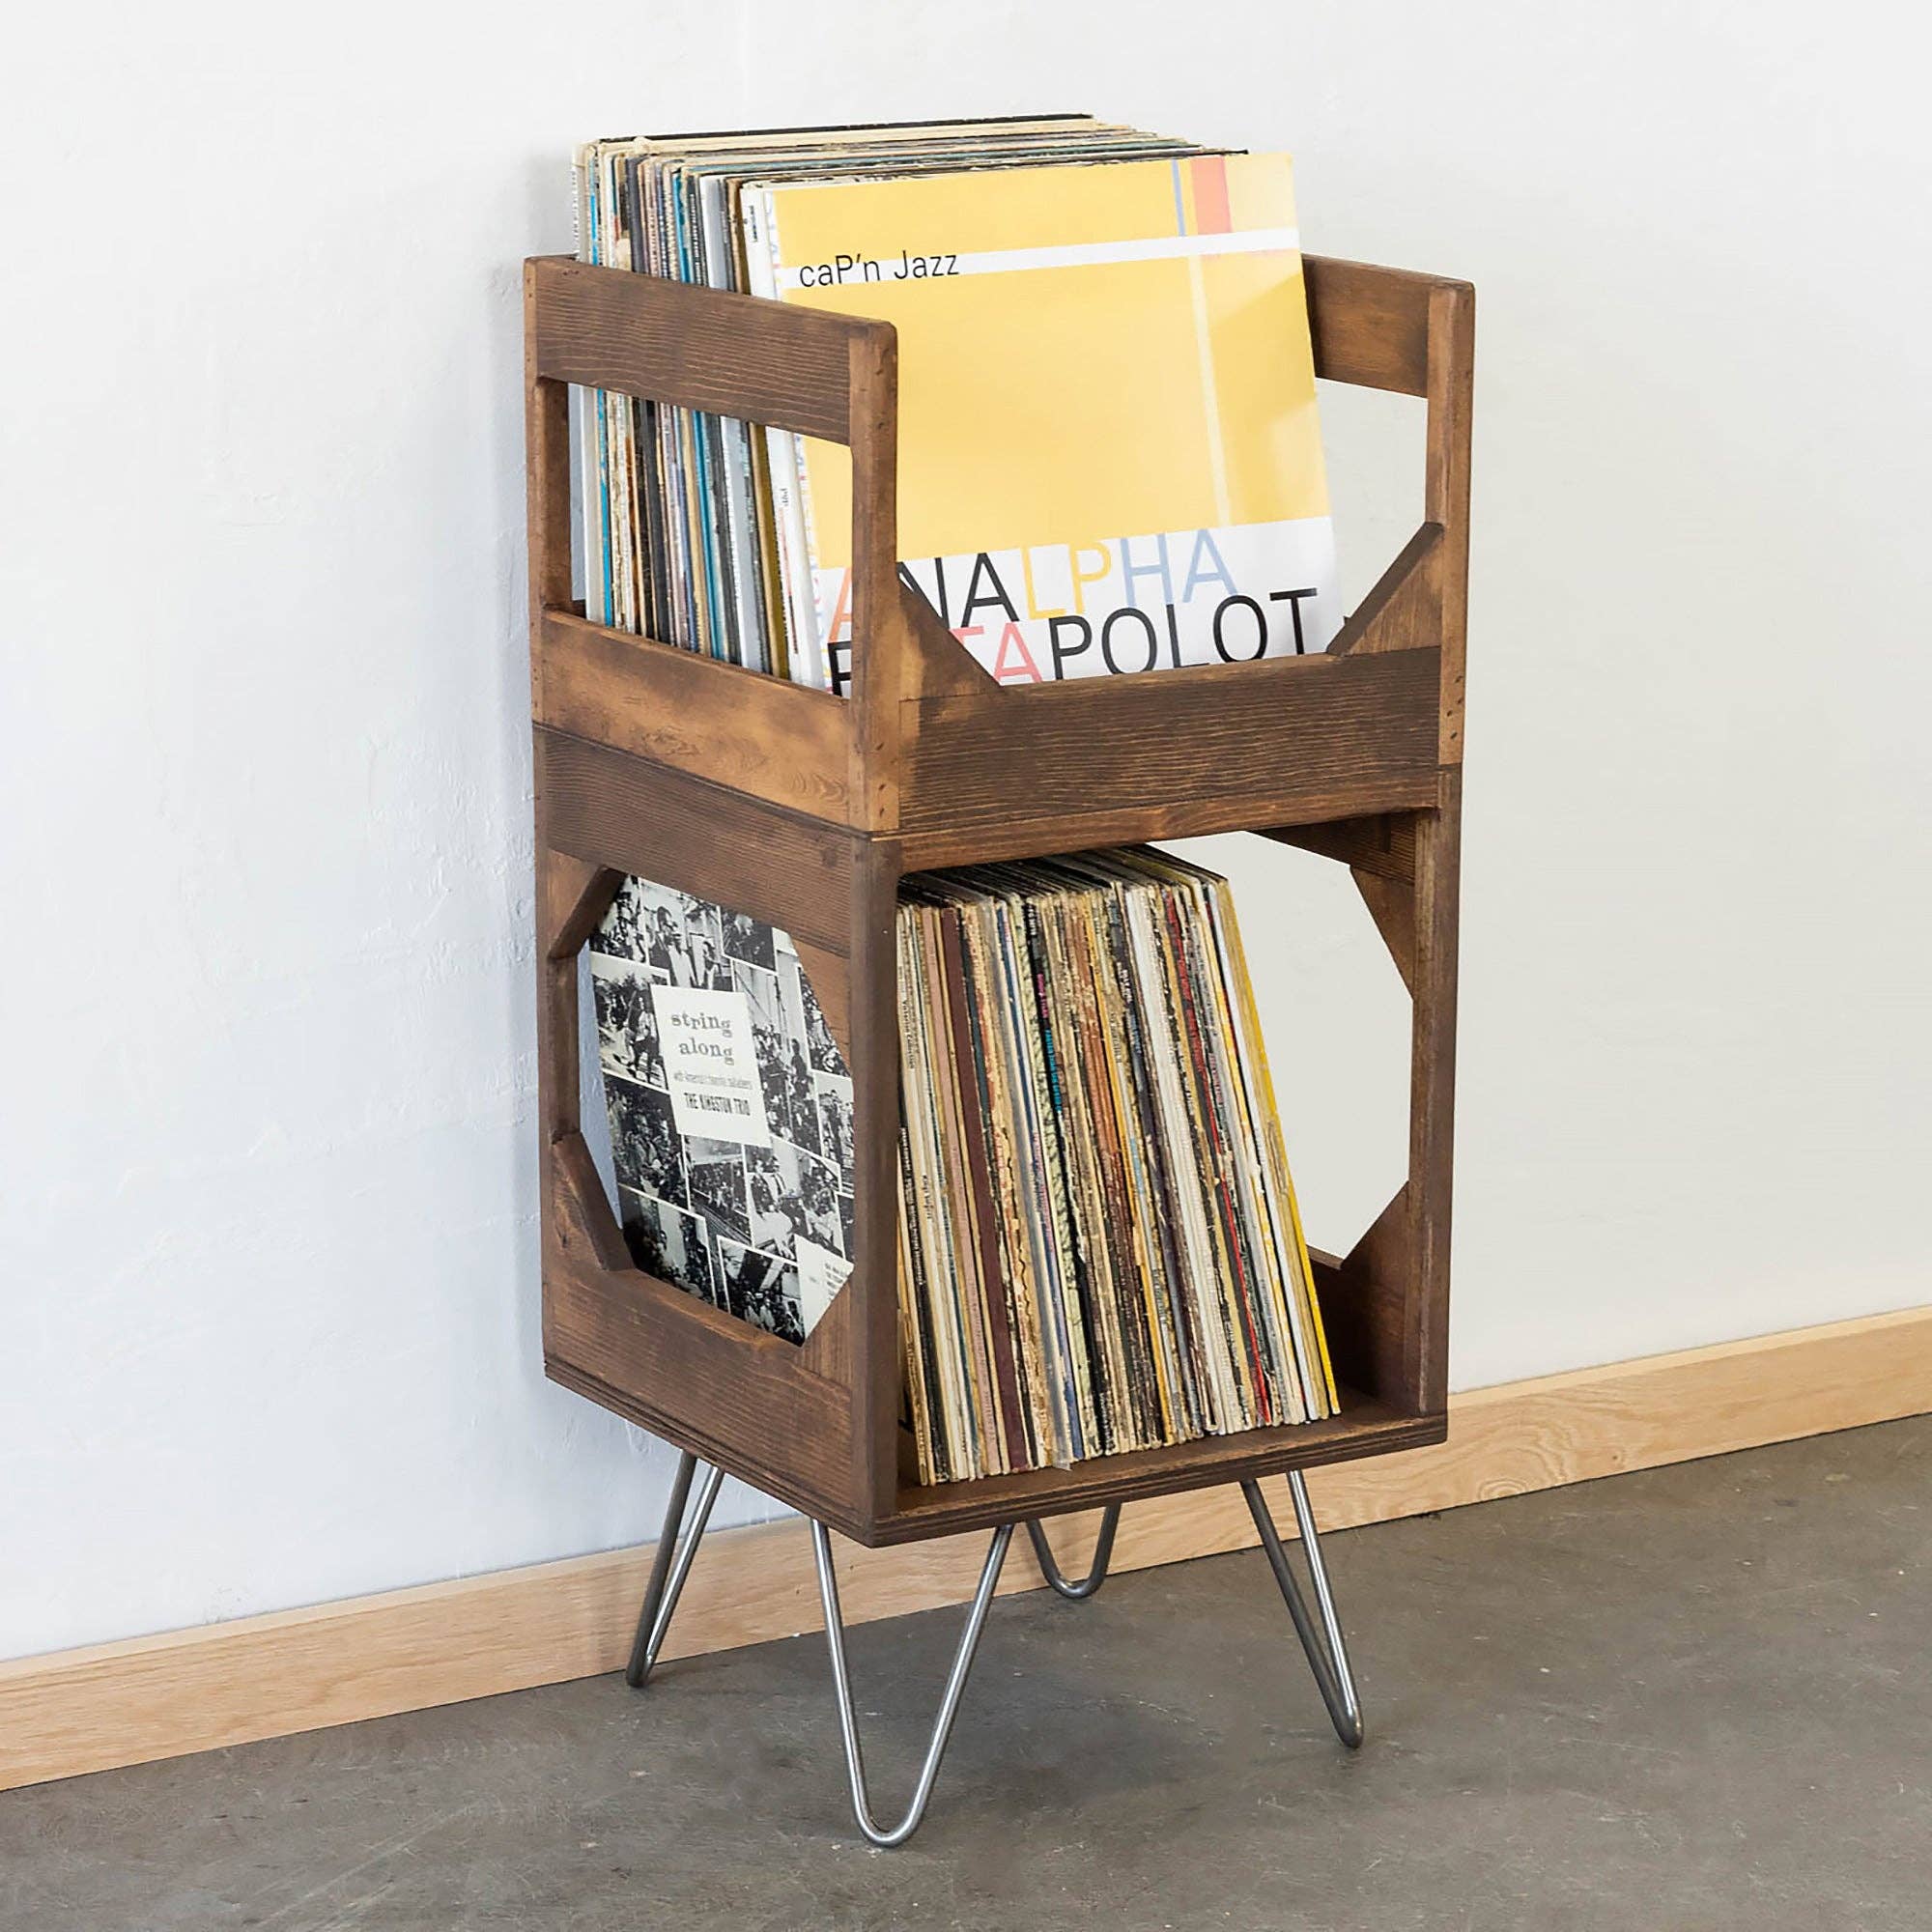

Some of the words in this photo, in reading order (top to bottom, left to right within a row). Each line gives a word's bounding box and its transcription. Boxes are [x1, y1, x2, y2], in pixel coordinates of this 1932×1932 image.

[894, 250, 959, 280] Jazz
[670, 1011, 733, 1038] string
[679, 1037, 735, 1066] along
